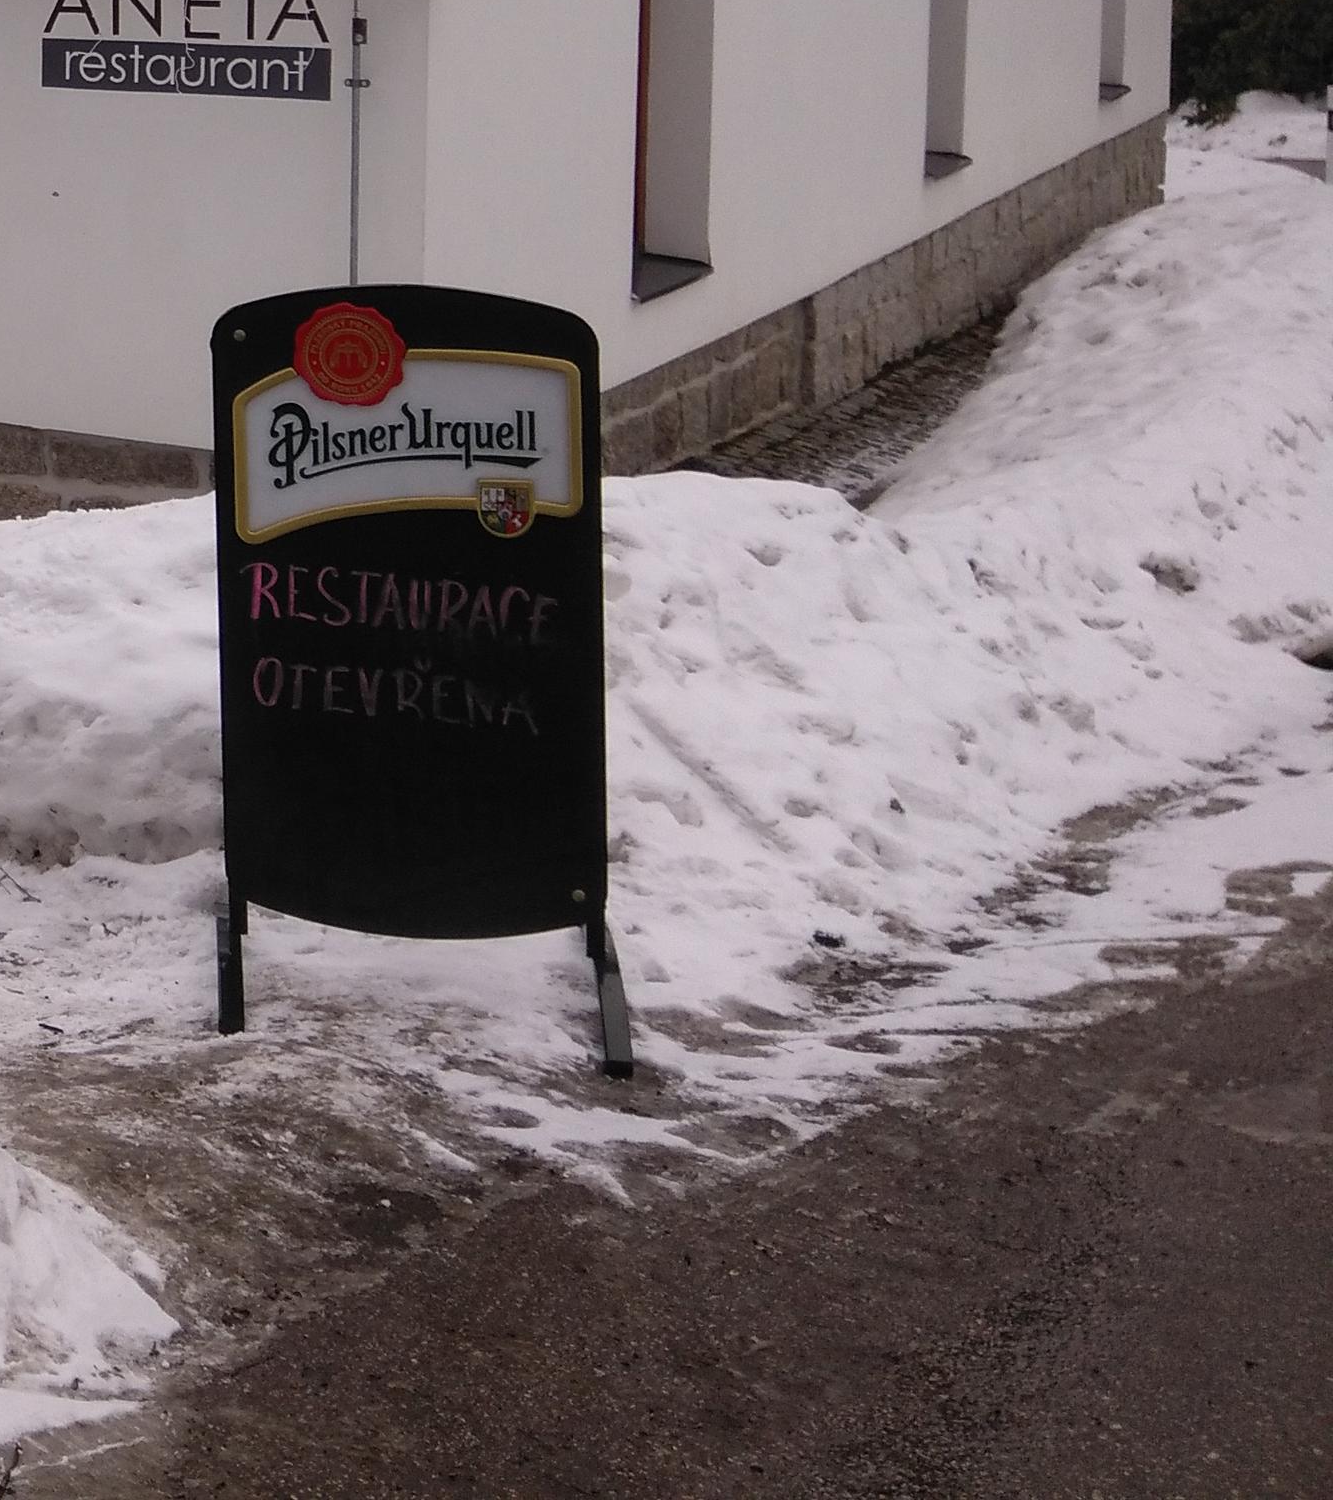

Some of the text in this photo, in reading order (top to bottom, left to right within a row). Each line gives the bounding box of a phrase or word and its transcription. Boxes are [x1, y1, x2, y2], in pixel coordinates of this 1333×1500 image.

[64, 44, 309, 92] restaurant
[267, 402, 538, 489] Pilsner Urquell
